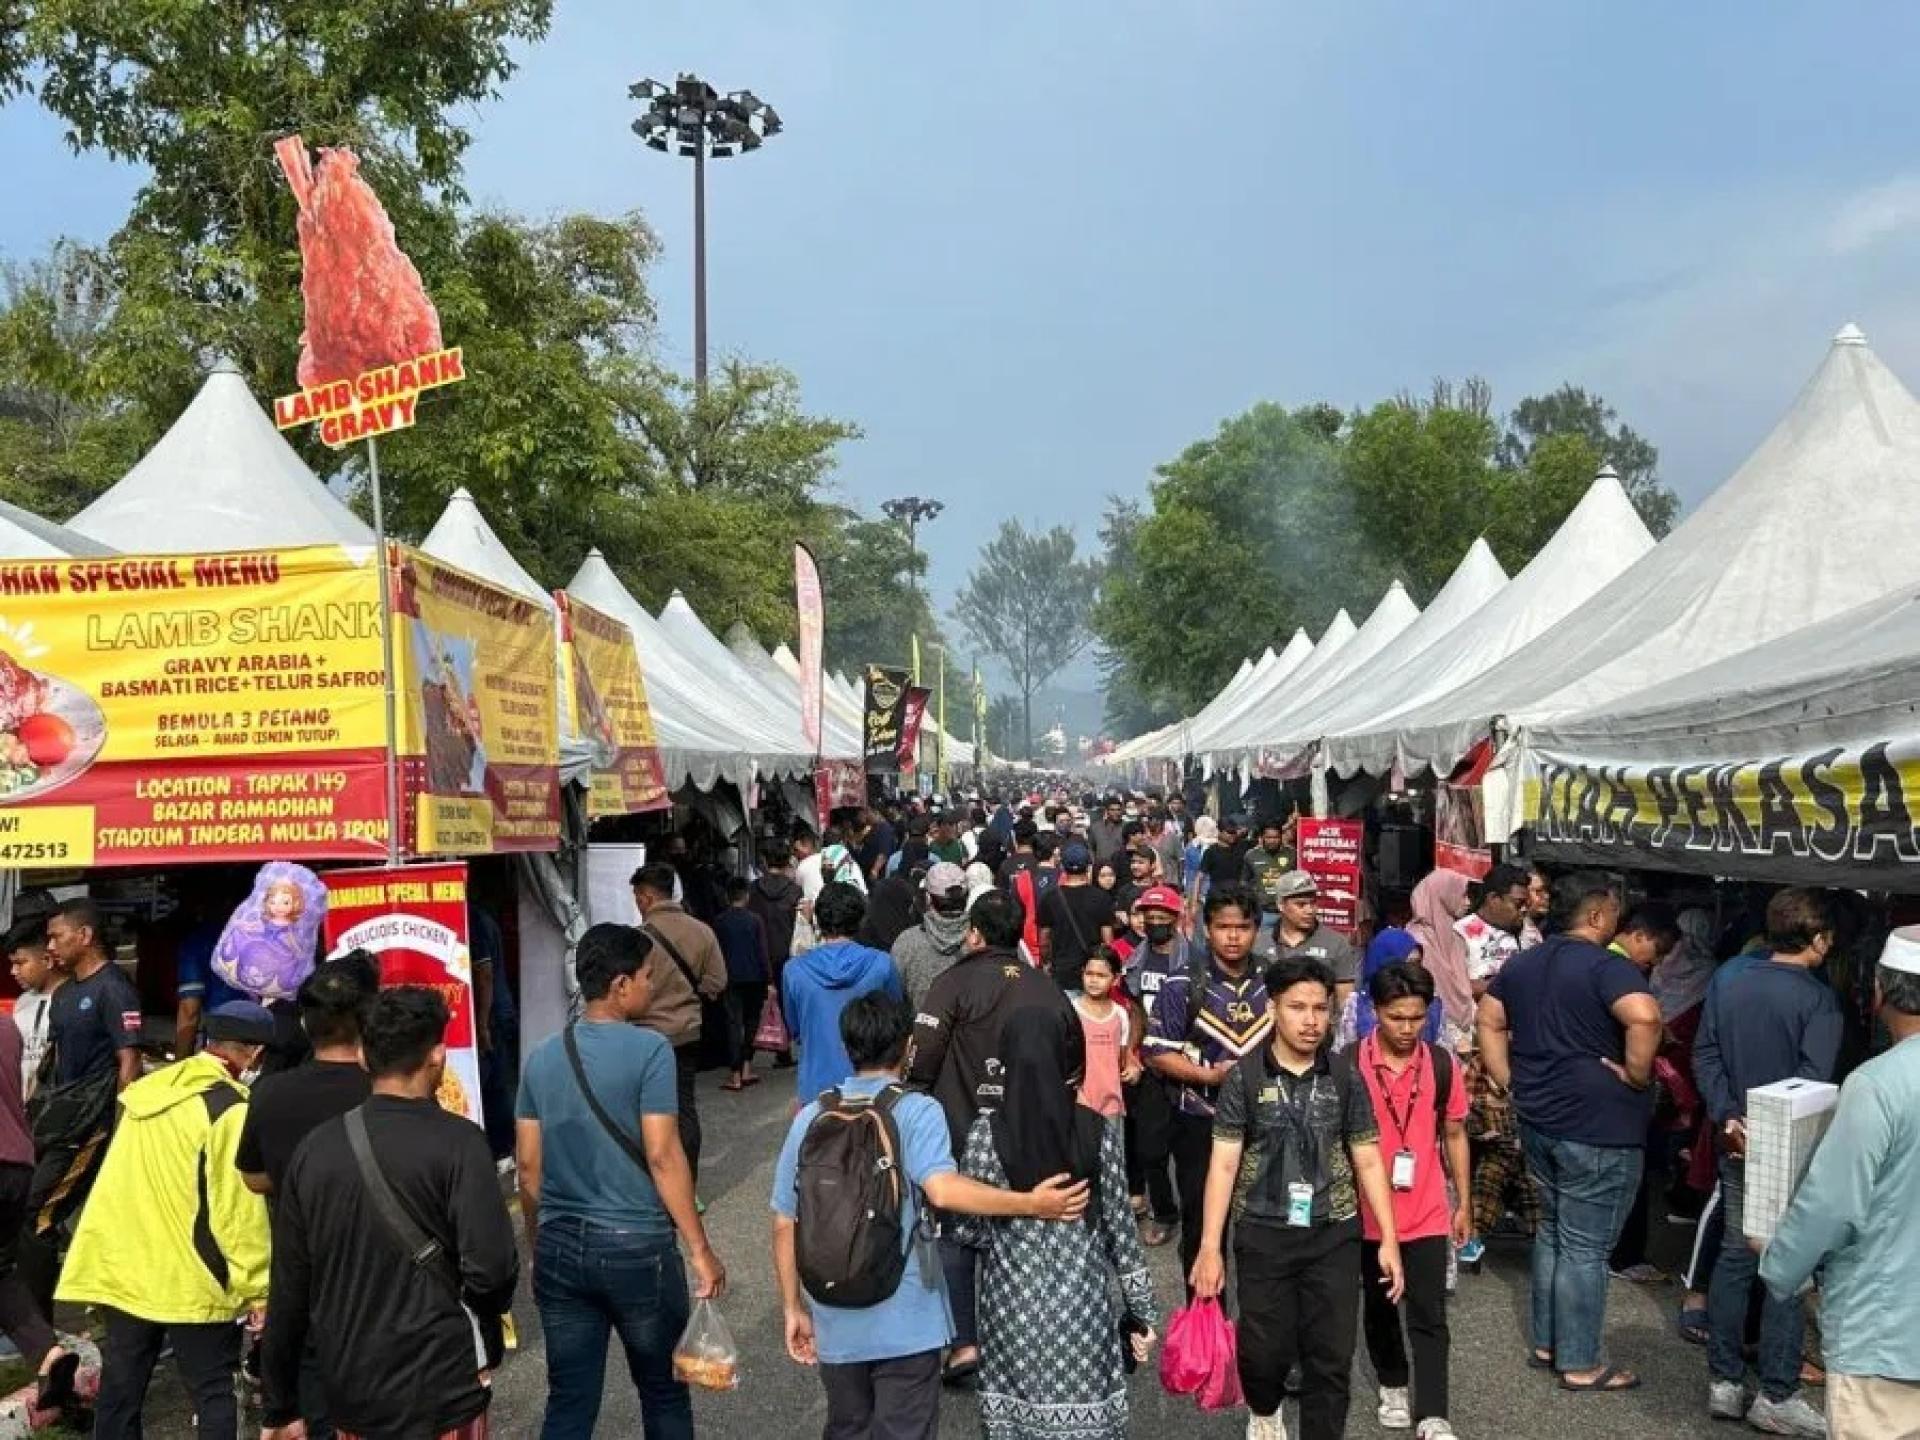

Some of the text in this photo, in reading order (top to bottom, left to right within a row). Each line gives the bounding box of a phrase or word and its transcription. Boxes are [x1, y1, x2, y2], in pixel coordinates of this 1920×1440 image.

[276, 351, 463, 425] LAMB SHANK
[323, 397, 415, 444] GRAVY
[67, 560, 186, 593] SPECIAL
[194, 555, 280, 587] MENU
[87, 601, 385, 651] LAMB SHANK
[164, 654, 326, 675] GRAVY ARABIA +
[101, 678, 190, 698] BASMATI
[158, 708, 331, 731] BEMULA 3 PETANG
[155, 733, 199, 748] SELASA
[213, 733, 248, 745] AHAD
[136, 777, 231, 799] LOCATION
[247, 773, 308, 794] TAPAK
[314, 772, 346, 792] 149
[153, 797, 334, 822] BAZAR RAMADHAN
[98, 818, 389, 849] STADIUM INDERA MULIA IPOH
